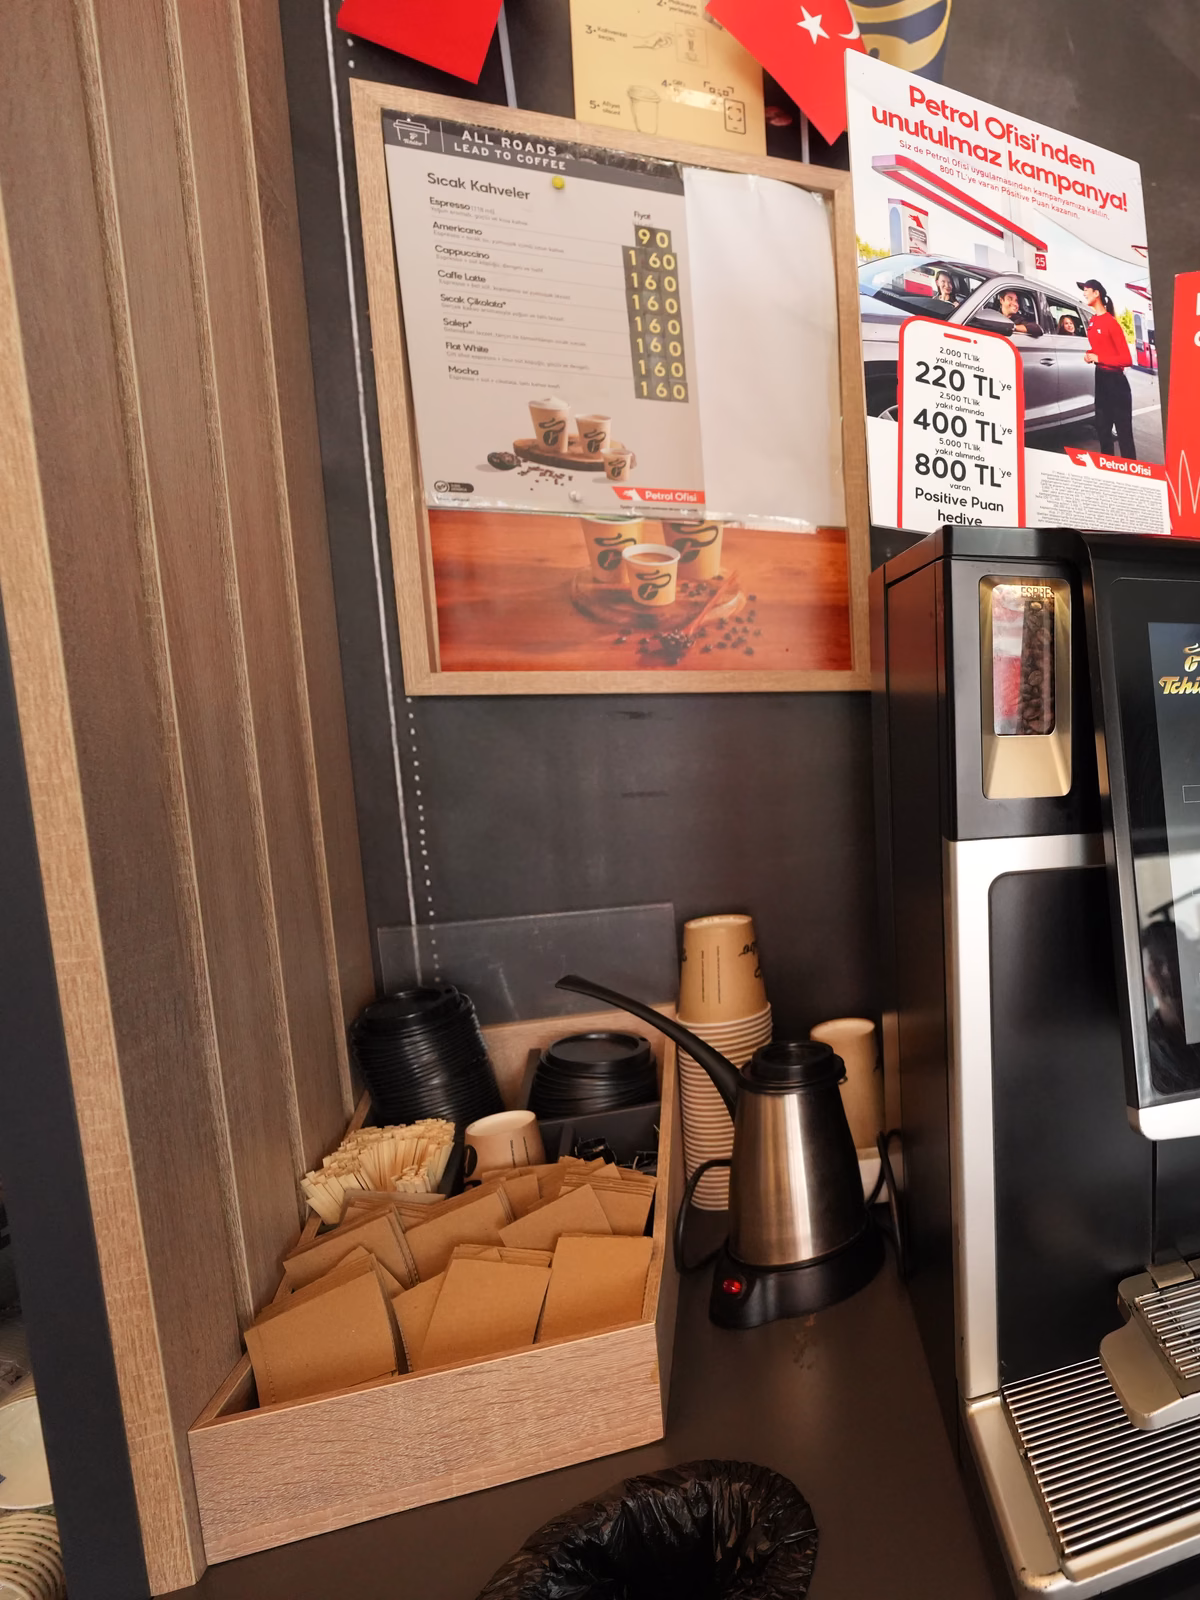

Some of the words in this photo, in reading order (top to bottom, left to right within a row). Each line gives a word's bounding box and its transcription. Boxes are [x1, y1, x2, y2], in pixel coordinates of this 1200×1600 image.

[909, 85, 979, 132] Petrol
[985, 116, 1095, 175] Ofisi'nden
[461, 130, 494, 146] ALL
[501, 137, 557, 157] ROADS
[454, 142, 489, 157] LEAD
[495, 150, 511, 161] TO
[516, 154, 566, 170] COFFEE
[872, 106, 1002, 167] unutulmaz
[1008, 150, 1128, 212] kampanya!
[899, 140, 912, 150] Siz
[914, 146, 924, 154] de
[926, 149, 950, 164] Petrol
[952, 159, 969, 170] Ofisi
[971, 166, 1032, 193] uygulamasından
[1034, 187, 1086, 212] kampanyamıza
[427, 172, 466, 190] Sıcak
[470, 180, 530, 200] Kahveler
[940, 165, 954, 175] 800
[956, 171, 976, 183] TL'ye
[978, 180, 1000, 192] varan
[1001, 186, 1030, 202] Positive
[1032, 196, 1050, 209] Puan
[429, 197, 471, 212] Espresso
[433, 221, 483, 236] Americano
[434, 244, 490, 260] Cappuccino
[437, 269, 463, 281] Caffe
[464, 273, 487, 283] Latte
[440, 293, 465, 305] Sıcak
[445, 341, 461, 351] Flat
[463, 343, 489, 354] White
[939, 346, 962, 359] 2.000
[448, 365, 479, 376] Mocha
[935, 356, 953, 365] yakıt
[955, 361, 985, 373] alımında
[915, 361, 965, 392] 220
[939, 391, 962, 403] 2.500
[935, 401, 954, 412] yakıt
[955, 404, 985, 417] alımında
[913, 408, 968, 438] 400
[938, 437, 961, 449] 5.000
[935, 447, 954, 458] yakıt
[955, 450, 985, 462] alımında
[915, 453, 967, 482] 800
[1099, 457, 1128, 472] Petrol
[1129, 463, 1151, 476] Ofisi
[949, 483, 971, 491] varan
[645, 490, 674, 501] Petrol
[675, 492, 697, 502] Ofisi
[915, 487, 967, 507] Positive
[971, 496, 1004, 512] Puan
[938, 509, 982, 526] hediye
